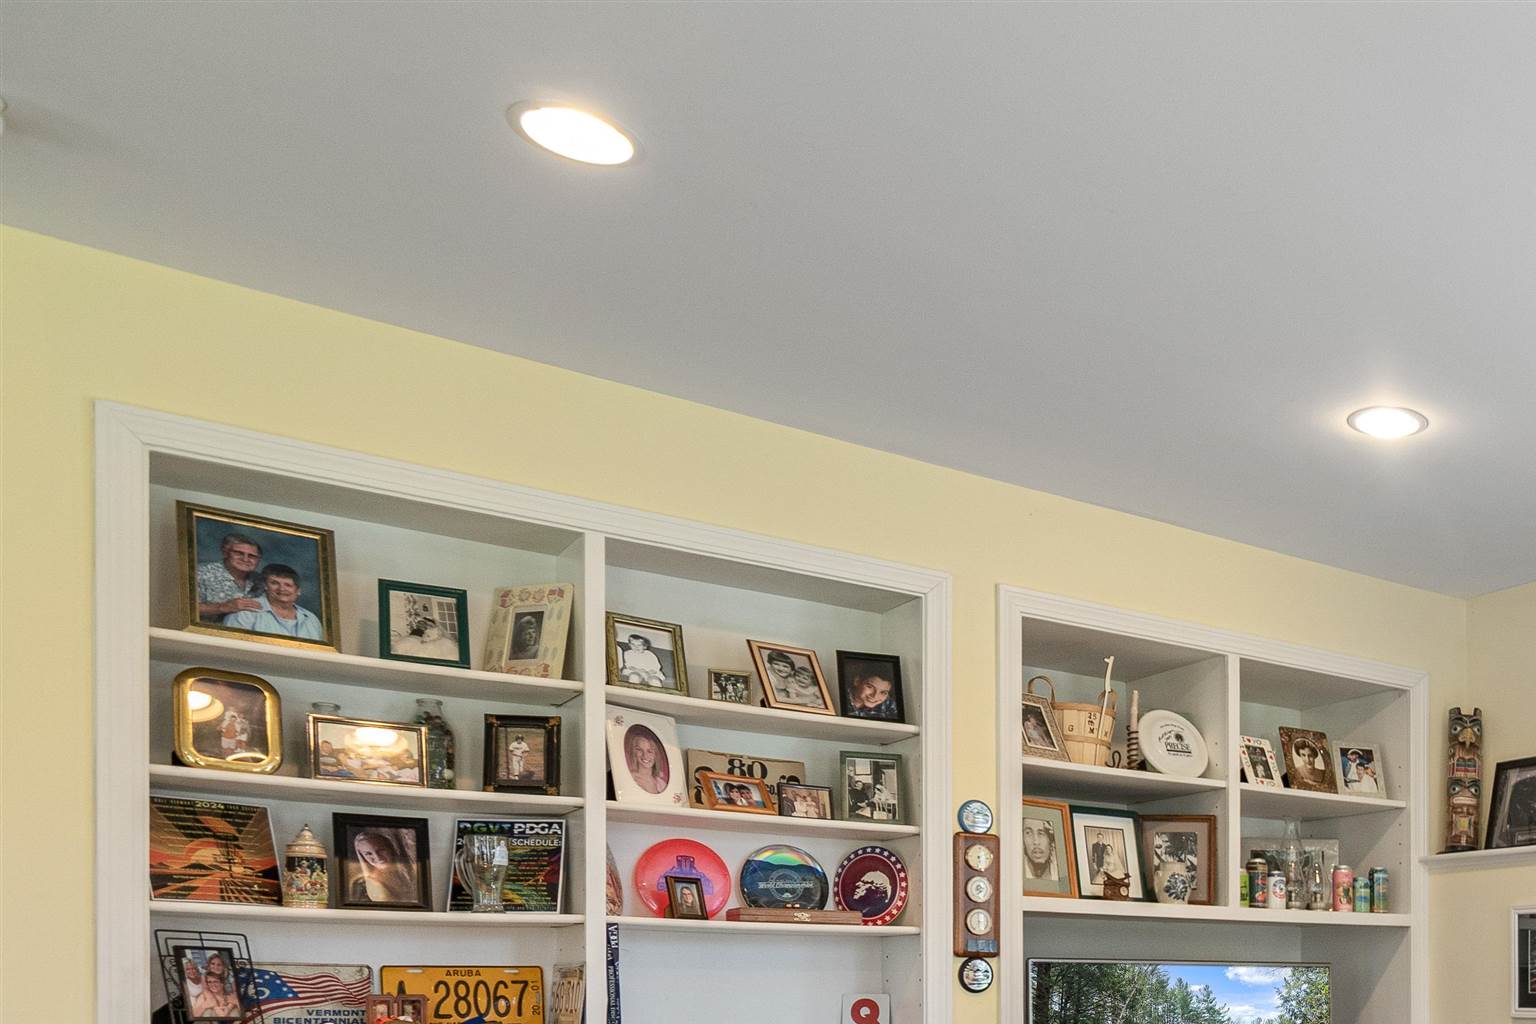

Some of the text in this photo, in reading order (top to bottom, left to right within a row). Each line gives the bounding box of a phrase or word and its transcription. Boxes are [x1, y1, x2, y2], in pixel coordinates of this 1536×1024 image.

[194, 800, 225, 810] 2024
[513, 823, 562, 835] PDGA
[511, 837, 561, 847] SCHEDULE:
[444, 968, 482, 978] ARUBA
[432, 979, 529, 1019] 28067
[305, 1008, 367, 1018] VERMONT
